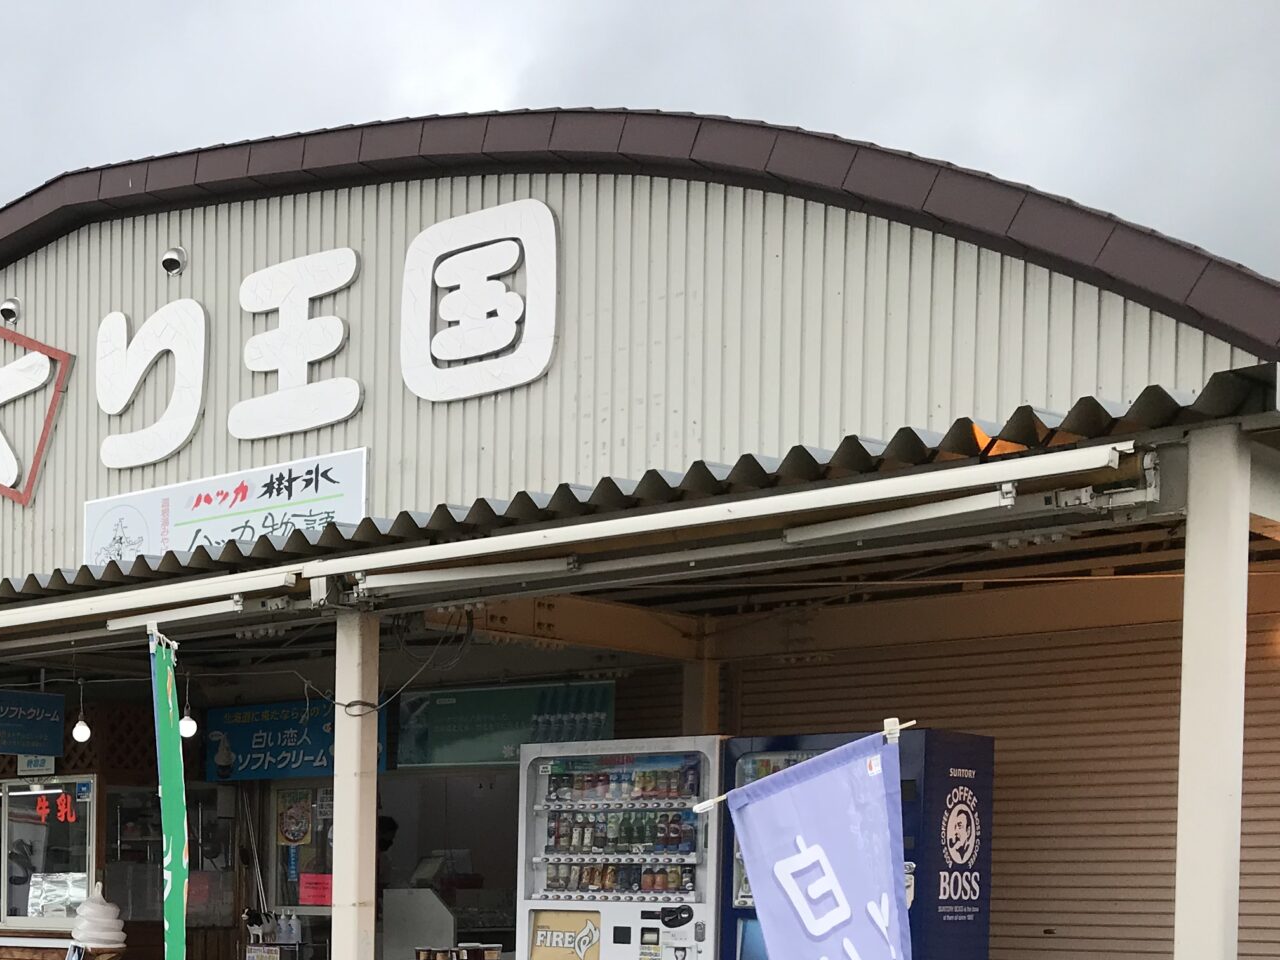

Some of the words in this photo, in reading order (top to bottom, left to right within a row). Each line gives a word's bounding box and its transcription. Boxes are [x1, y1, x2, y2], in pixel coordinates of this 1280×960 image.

[191, 480, 249, 511] ハッカ
[252, 728, 312, 749] 白い恋人
[238, 749, 327, 771] ソフトクリーム
[949, 767, 976, 778] SUNTORY
[36, 793, 76, 824] 牛乳
[946, 785, 978, 811] COFFEE
[938, 871, 980, 900] BOSS
[535, 930, 576, 949] FIRE
